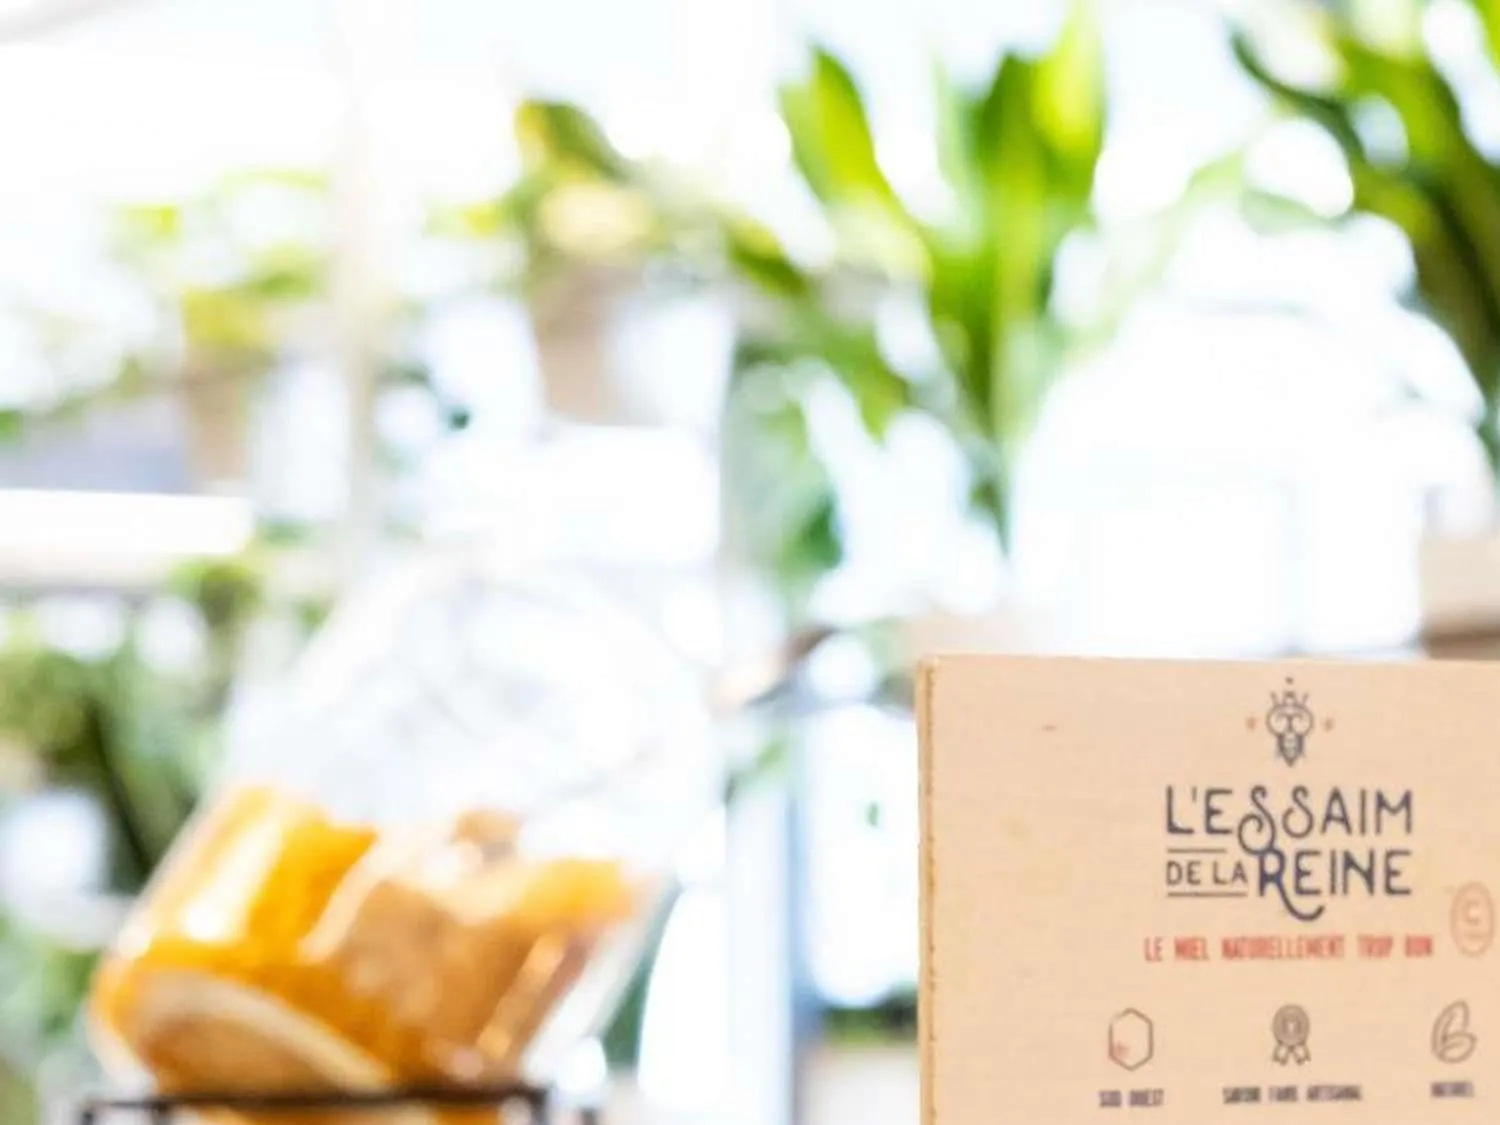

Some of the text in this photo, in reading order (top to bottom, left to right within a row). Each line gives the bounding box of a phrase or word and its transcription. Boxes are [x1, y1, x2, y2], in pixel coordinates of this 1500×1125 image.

[1165, 785, 1412, 853] L'ESSAIM
[1165, 848, 1412, 922] DE LA REINE
[1144, 936, 1163, 961] LE
[1174, 936, 1209, 960] MIEL
[1220, 934, 1345, 960] NATURELLEMENT
